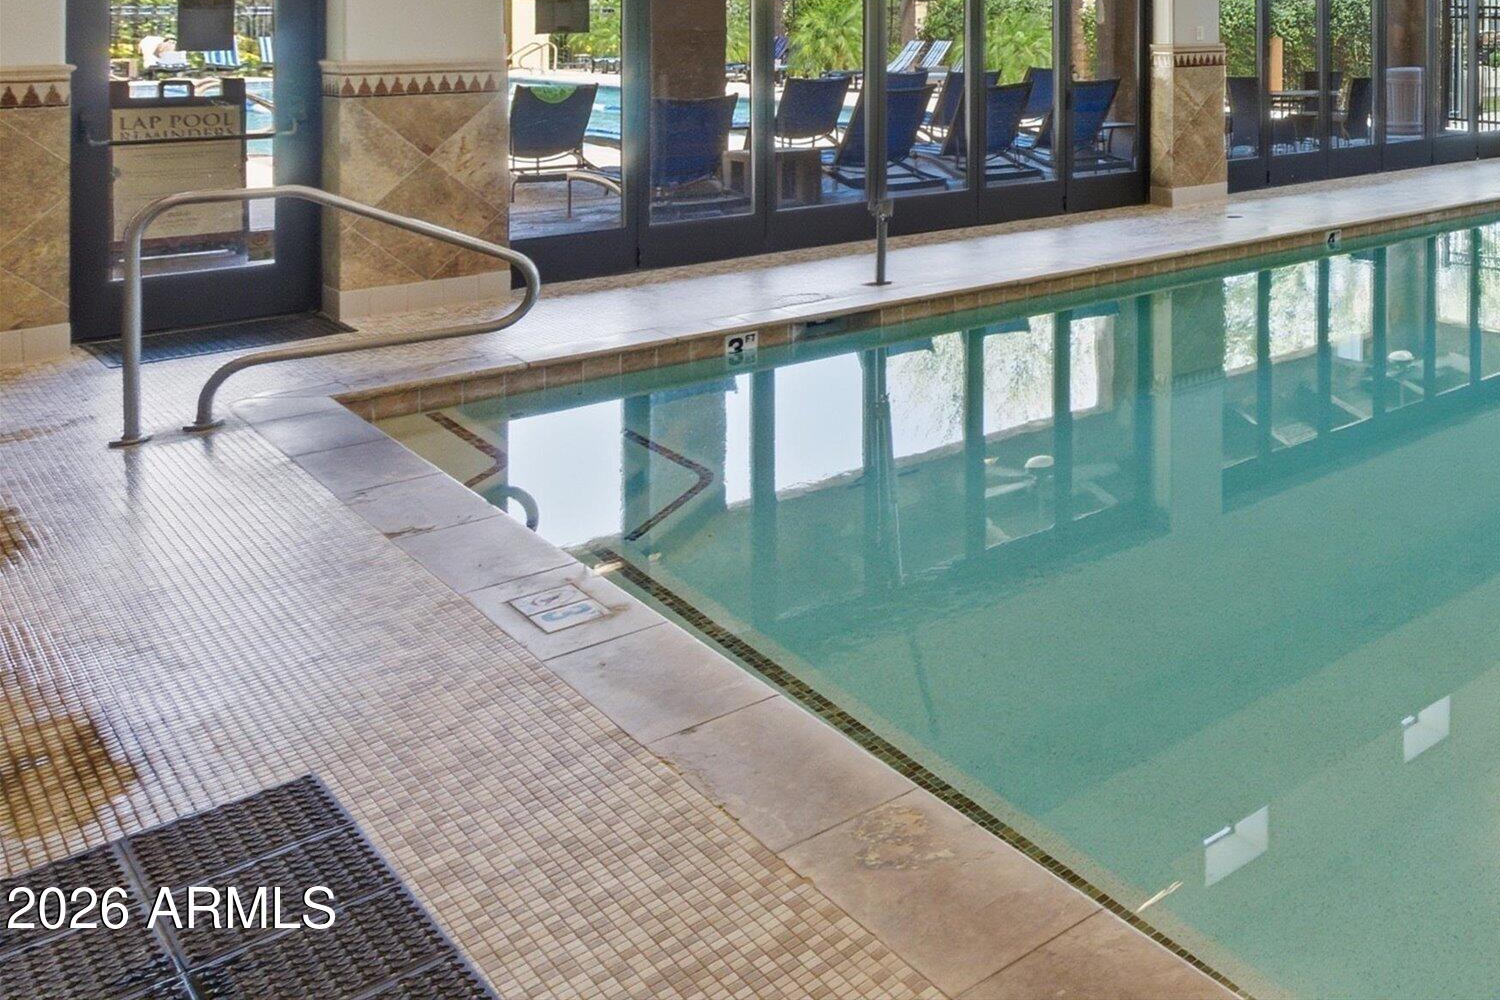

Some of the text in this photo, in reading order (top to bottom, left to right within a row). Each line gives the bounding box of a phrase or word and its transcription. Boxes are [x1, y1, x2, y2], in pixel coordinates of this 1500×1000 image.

[120, 112, 234, 131] LAP POOL
[745, 333, 756, 343] FT
